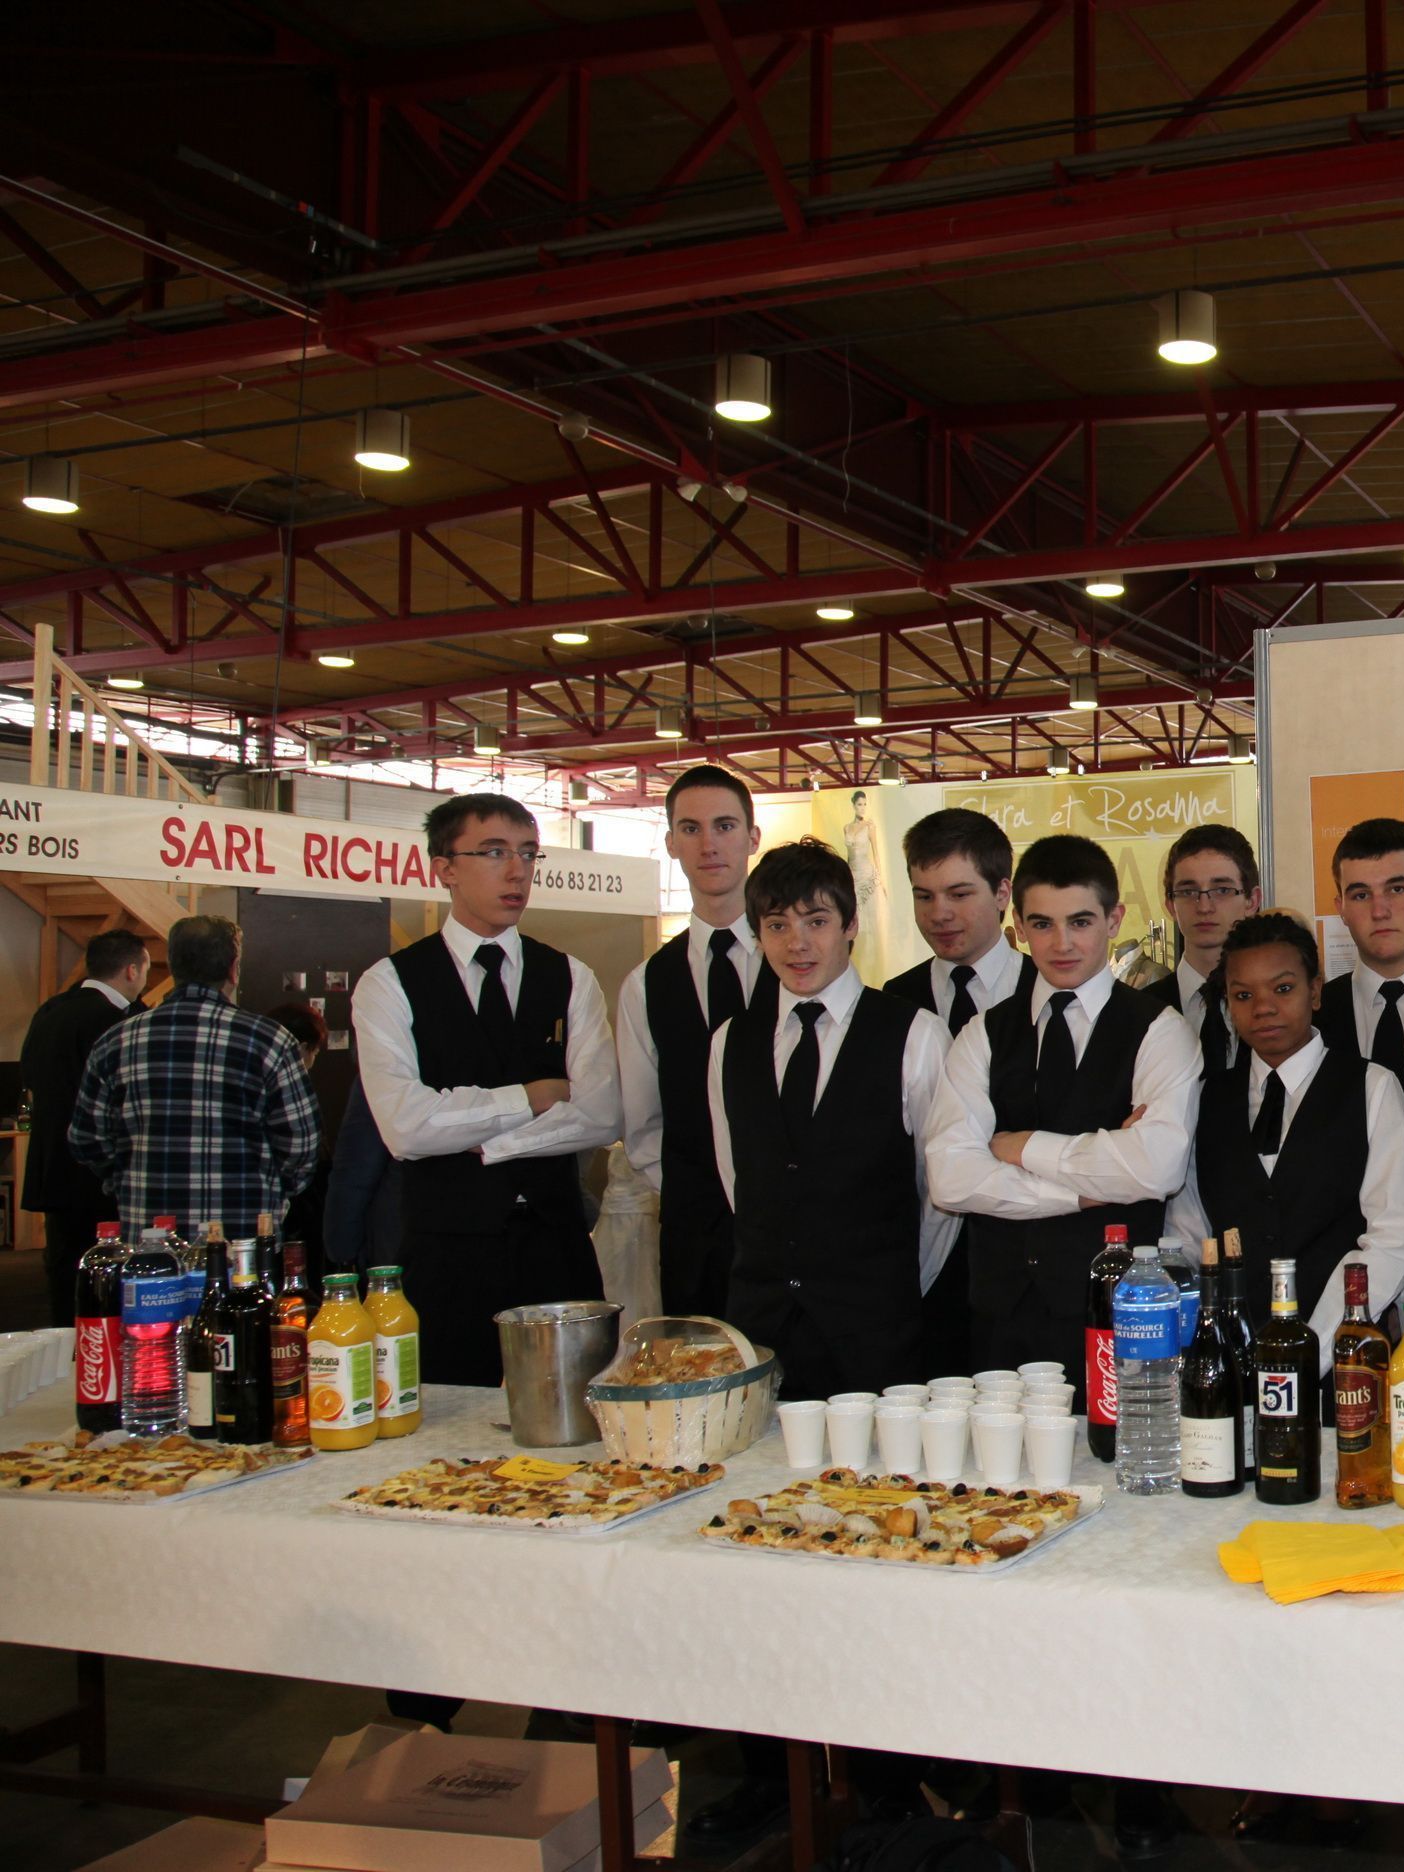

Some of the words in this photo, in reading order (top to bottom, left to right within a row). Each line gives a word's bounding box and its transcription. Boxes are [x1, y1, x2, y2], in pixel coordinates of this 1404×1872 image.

[0, 798, 43, 823] ANT
[1049, 795, 1086, 829] et
[1088, 786, 1227, 835] Rosanna
[27, 835, 79, 860] BOIS
[159, 816, 276, 875] SARL
[546, 869, 564, 889] 66
[568, 871, 585, 891] 83
[588, 873, 602, 893] 21
[606, 874, 623, 894] 23
[1131, 1323, 1164, 1332] SOURCE
[1262, 1380, 1294, 1412] 51
